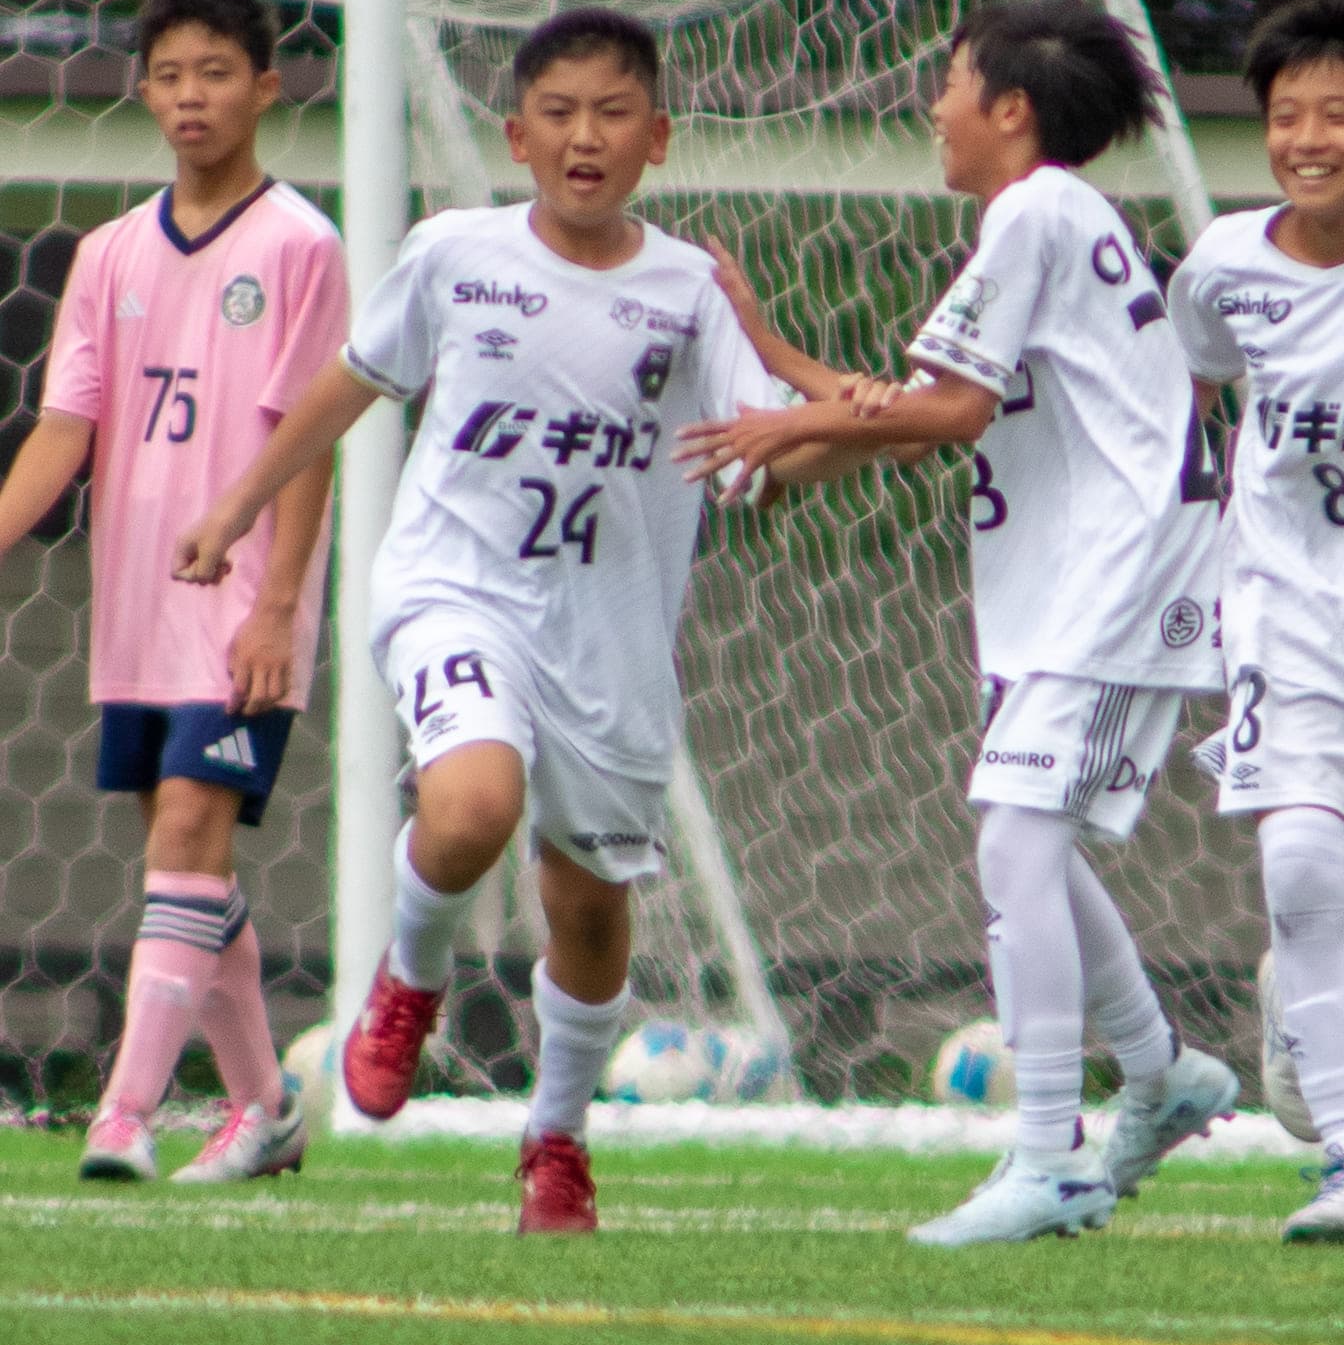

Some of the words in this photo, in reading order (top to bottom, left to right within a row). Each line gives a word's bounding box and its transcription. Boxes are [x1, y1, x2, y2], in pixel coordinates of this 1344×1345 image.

[452, 280, 548, 317] Shinko
[1217, 292, 1293, 324] Shinko
[143, 366, 198, 443] 75
[519, 476, 604, 565] 24
[1230, 664, 1266, 754] 8
